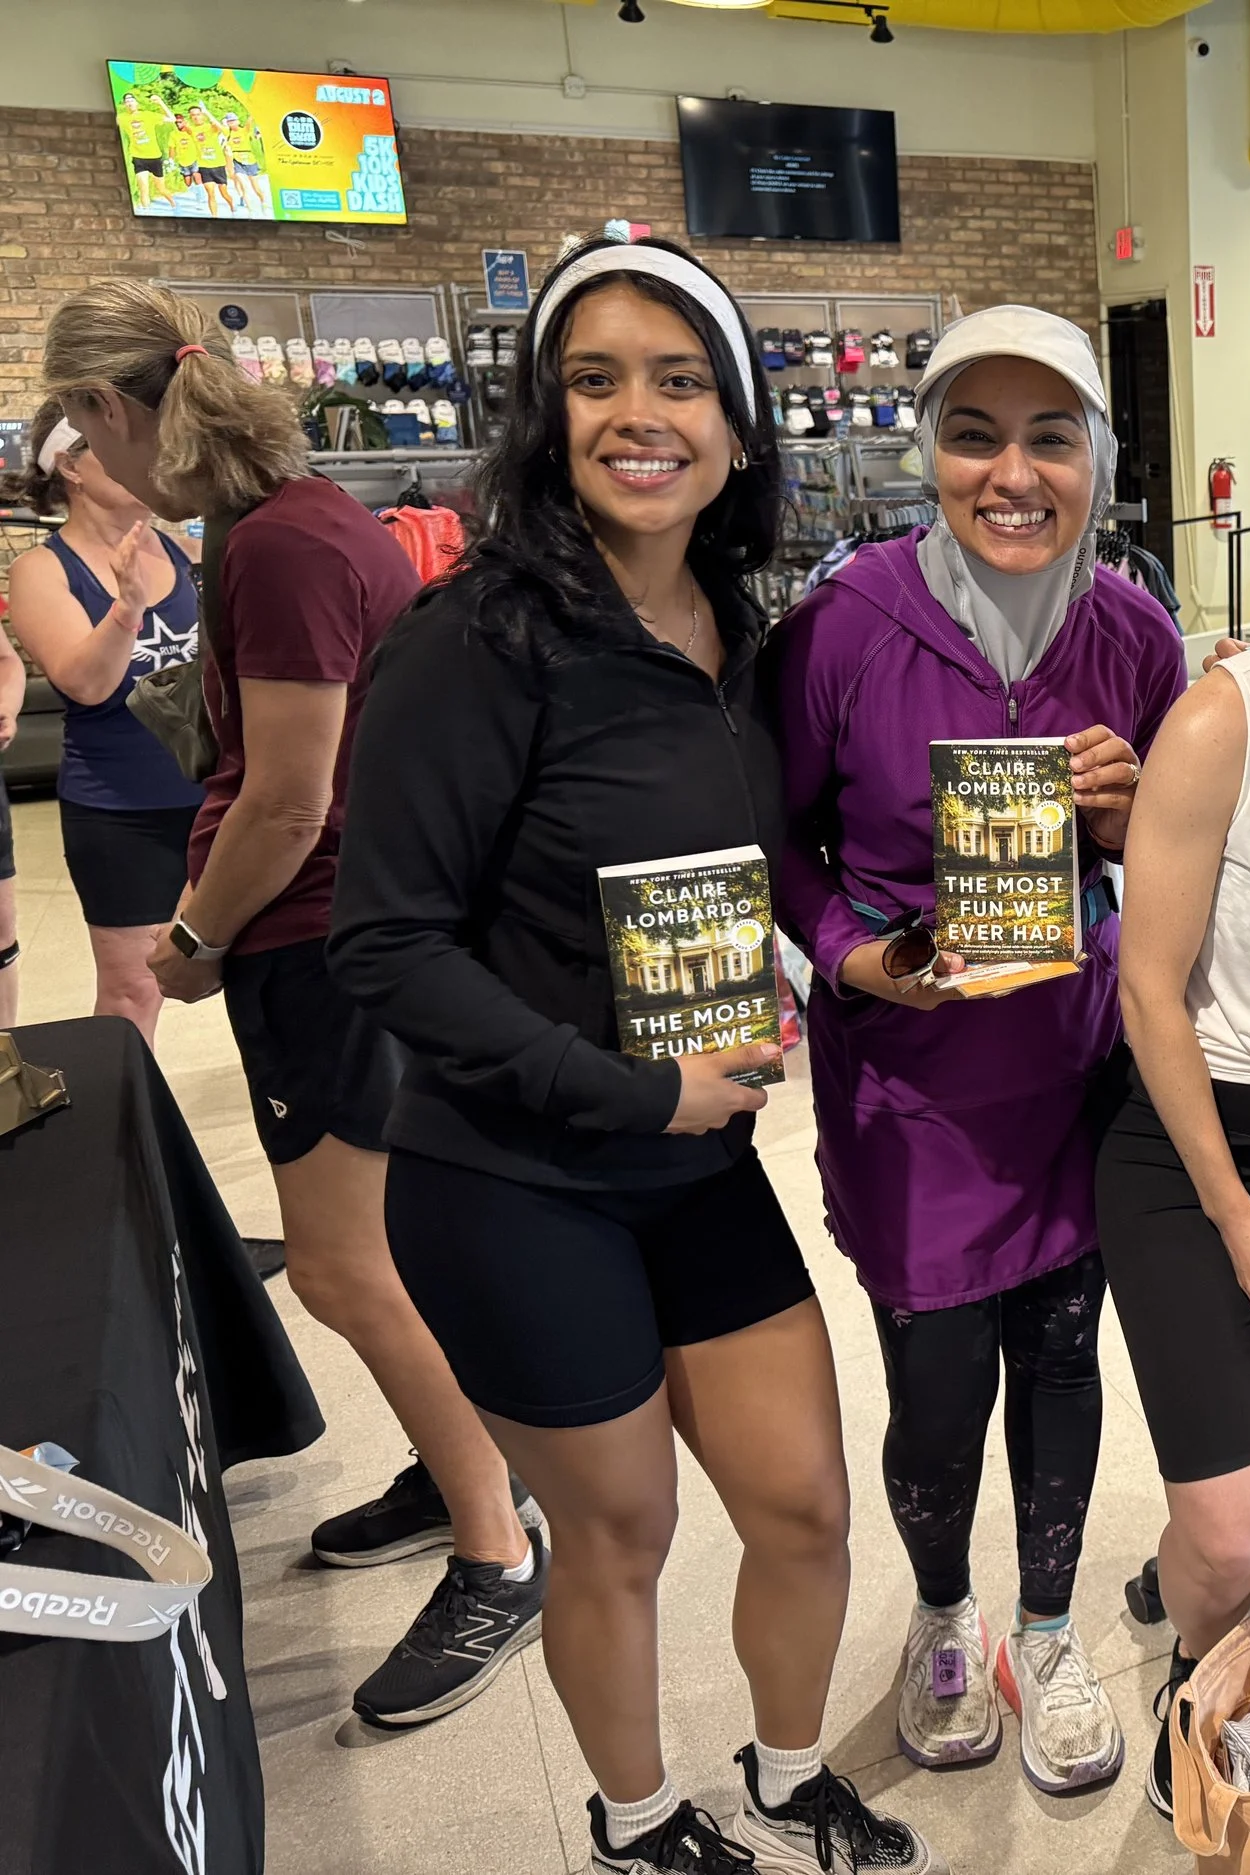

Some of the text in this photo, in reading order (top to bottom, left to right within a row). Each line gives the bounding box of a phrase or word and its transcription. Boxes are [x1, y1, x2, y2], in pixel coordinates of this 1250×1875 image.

[364, 136, 396, 156] 5K
[359, 154, 397, 174] 10K
[352, 172, 399, 192] KIDS
[347, 190, 403, 212] DASH
[1195, 271, 1211, 281] FIRE
[159, 645, 181, 656] RUN
[968, 762, 1036, 776] CLAIRE
[947, 781, 1056, 796] LOMBARDO
[630, 866, 741, 885] NEW YORK TIMES BESTSELLER
[944, 876, 1063, 894] THE MOST
[649, 882, 727, 904] CLAIRE
[626, 900, 751, 929] LOMBARDO
[960, 900, 1049, 917] FUN WE
[948, 924, 1061, 941] EVER HAD
[630, 997, 766, 1036] THE MOST
[652, 1025, 753, 1060] FUN WE
[51, 1494, 171, 1566] Reebok
[0, 1588, 119, 1626] Reebo
